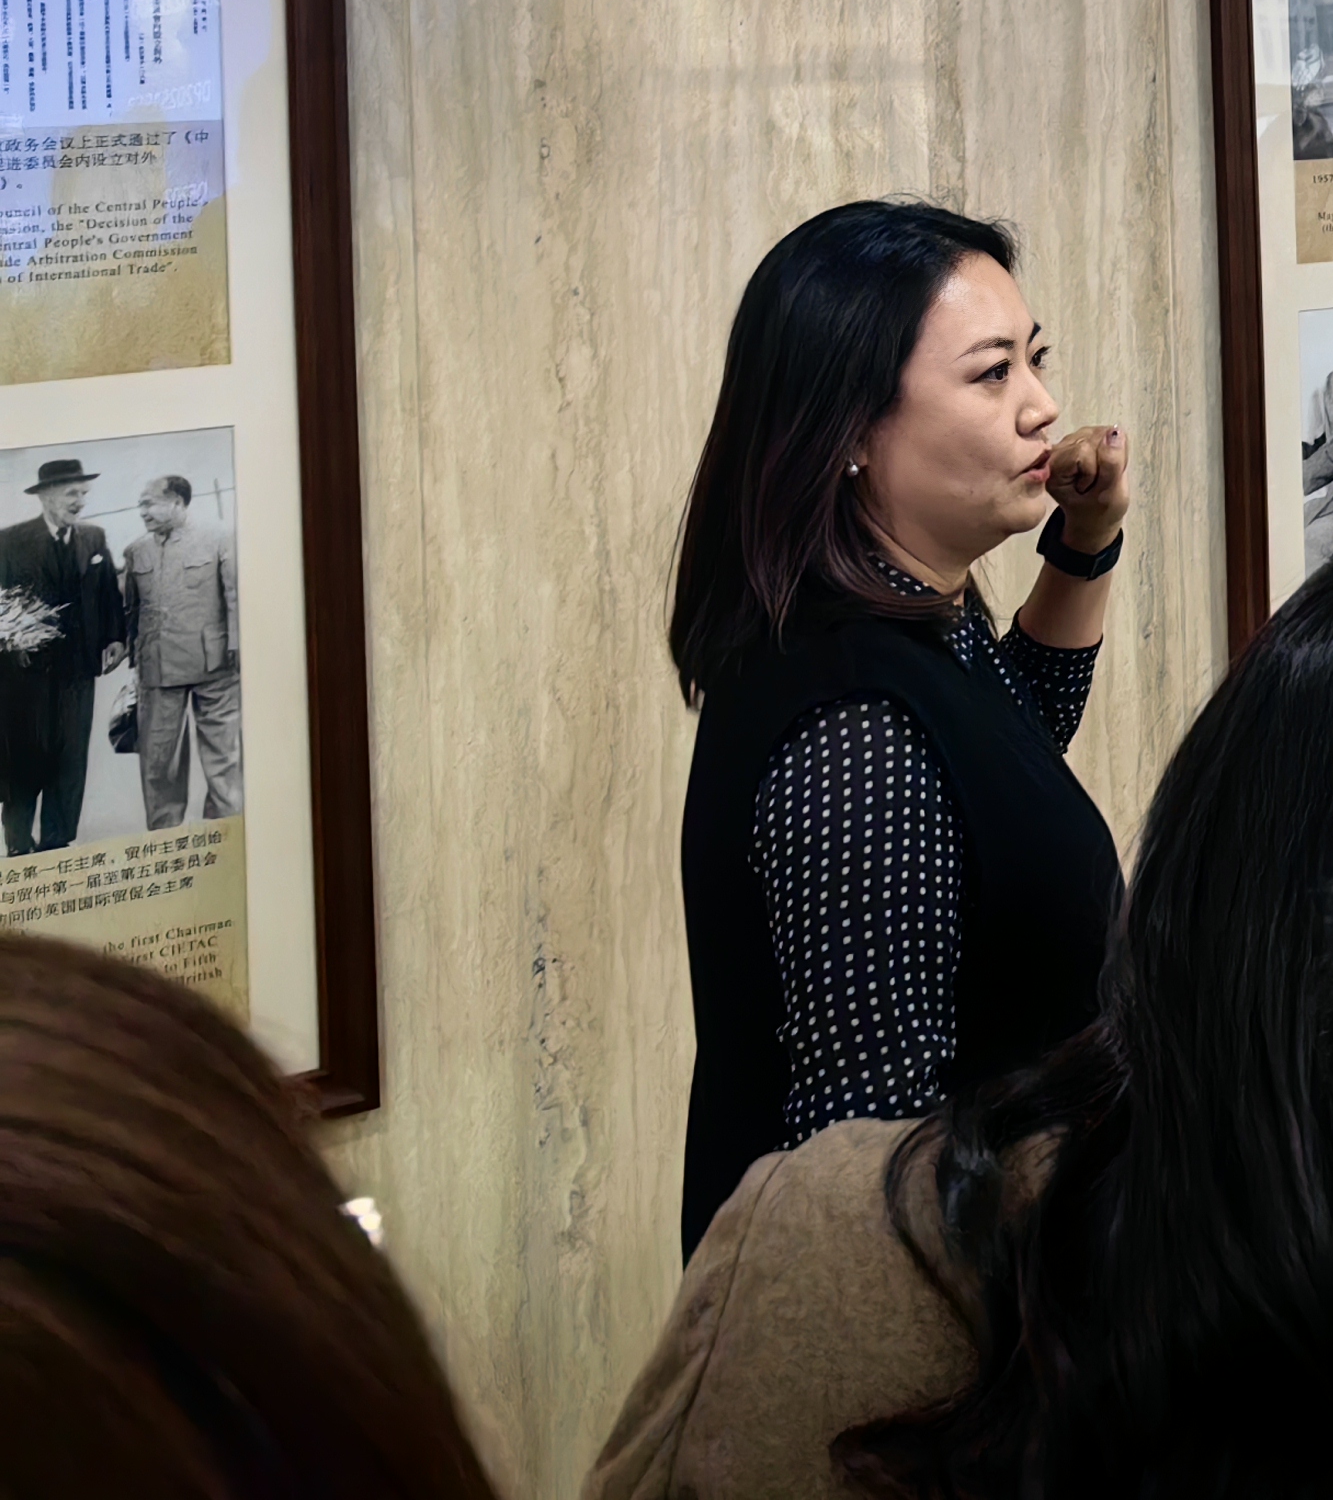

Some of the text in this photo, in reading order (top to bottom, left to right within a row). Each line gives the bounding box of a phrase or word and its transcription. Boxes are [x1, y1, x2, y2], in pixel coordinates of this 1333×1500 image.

[0, 130, 209, 152] 政务会议上正式通过了《中
[47, 203, 65, 216] of
[69, 201, 90, 215] the
[95, 197, 147, 213] Central
[51, 219, 73, 232] the
[153, 212, 169, 225] of
[172, 212, 193, 224] the
[0, 230, 193, 252] ntral People's Government
[27, 251, 107, 268] Arbitration
[112, 245, 198, 261] Commission
[7, 271, 24, 284] of
[28, 264, 121, 283] International
[0, 831, 222, 886] 会第一任主席、贸仲主要创始
[165, 919, 233, 940] Chairman
